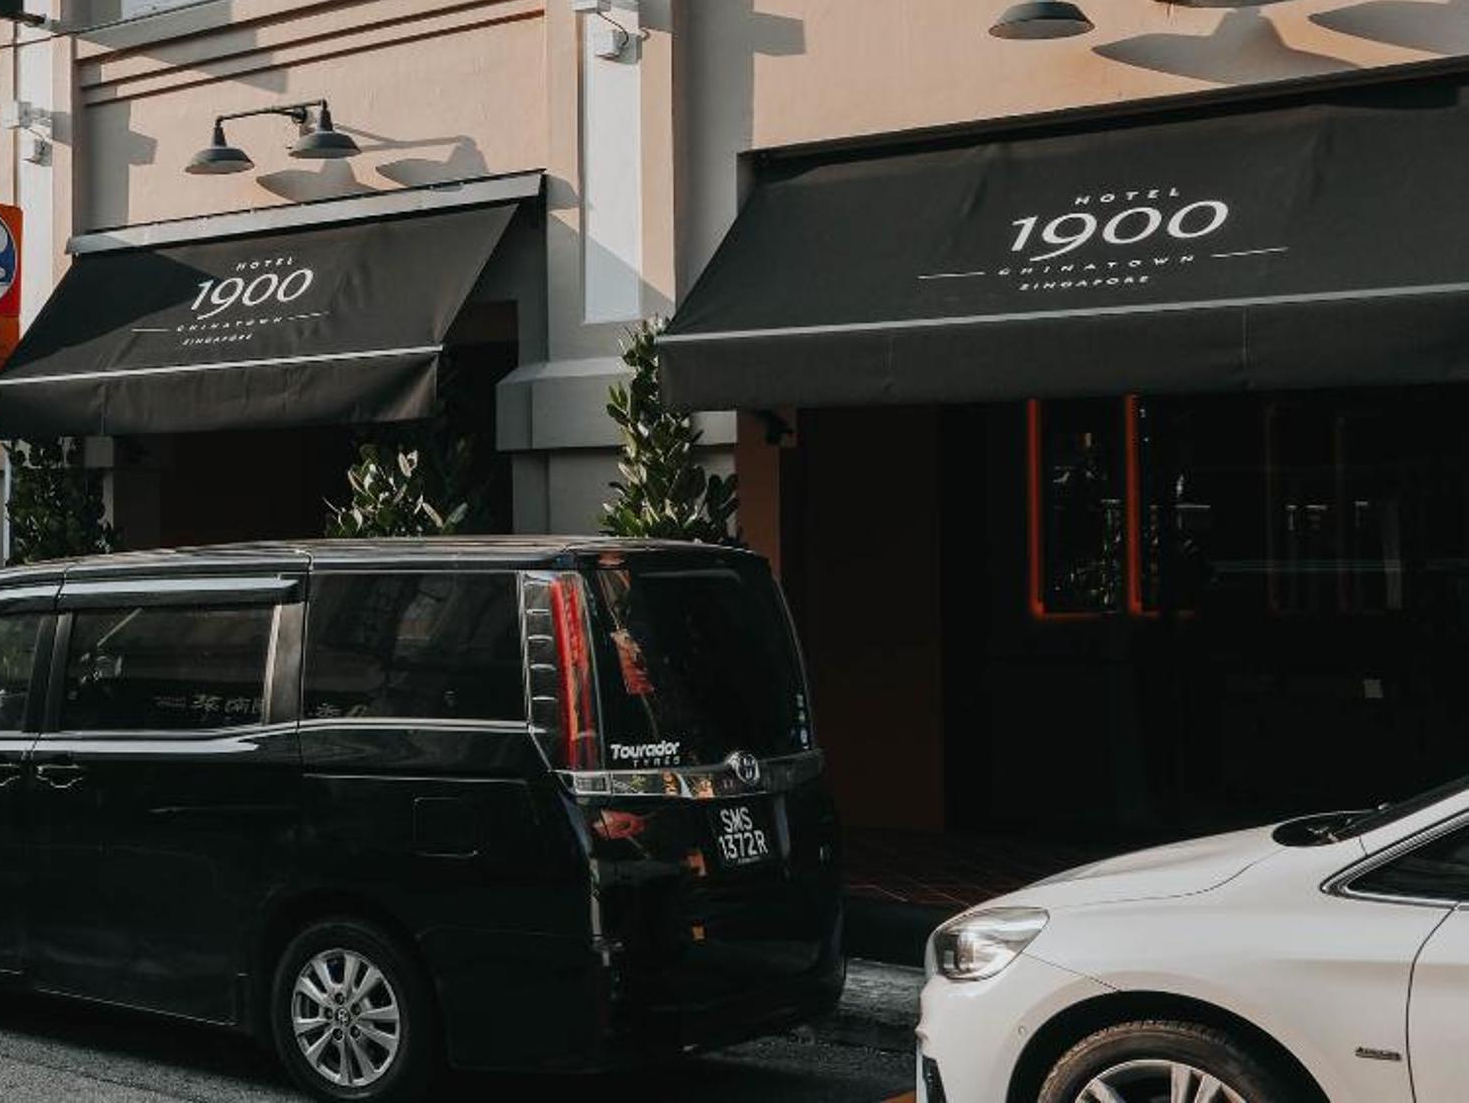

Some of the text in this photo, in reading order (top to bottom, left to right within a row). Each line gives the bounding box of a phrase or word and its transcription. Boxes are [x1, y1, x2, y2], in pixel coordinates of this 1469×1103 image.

[1074, 187, 1180, 205] HOTEL
[1010, 200, 1229, 262] 1900
[236, 257, 294, 272] HOTEL
[998, 255, 1194, 275] CHINATOWN
[1019, 276, 1150, 291] SINGAPORE
[190, 268, 314, 321] 1900
[610, 740, 680, 759] Tourador
[720, 806, 753, 834] SMS
[718, 829, 769, 860] 1372R
